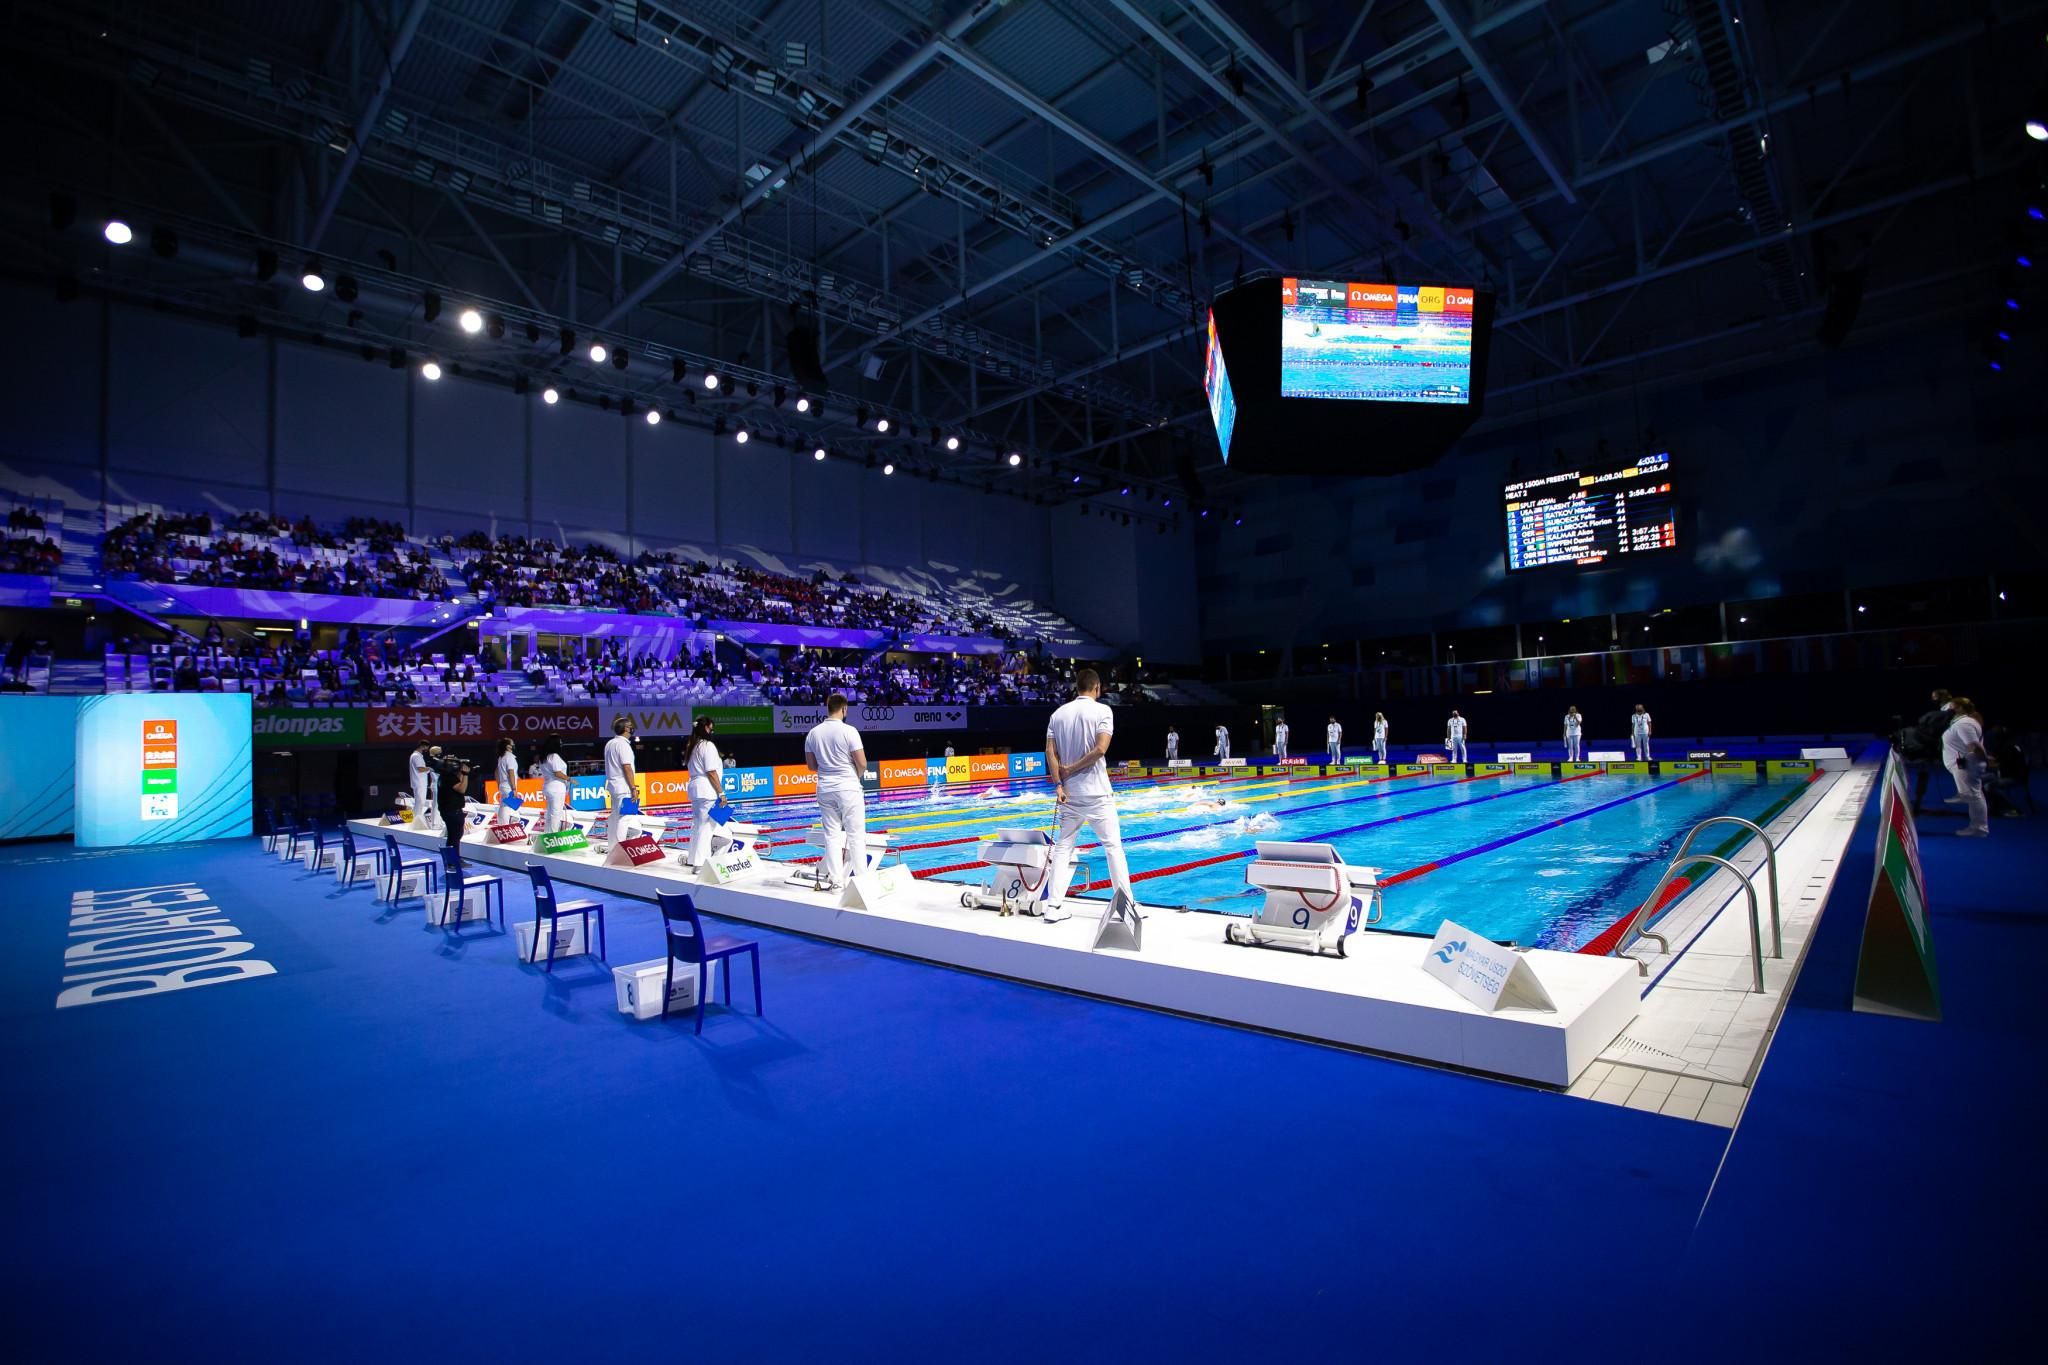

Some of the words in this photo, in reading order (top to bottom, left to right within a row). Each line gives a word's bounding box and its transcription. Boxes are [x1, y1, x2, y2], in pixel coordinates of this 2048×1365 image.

[1363, 292, 1393, 302] OMEGA
[1525, 479, 1545, 489] 1500M
[1546, 471, 1580, 483] FREESTYLE
[1505, 491, 1522, 500] HEAT
[1520, 501, 1536, 510] SPLIT
[525, 715, 593, 730] OMEGA
[914, 712, 941, 723] arena
[253, 715, 344, 736] alonpas
[376, 712, 482, 737] 农夫山泉
[894, 767, 924, 778] OMEGA
[981, 763, 1006, 771] OMEGA
[741, 778, 768, 786] RESULTS
[791, 774, 818, 784] OMEG
[741, 785, 755, 793] APP
[637, 844, 659, 856] OMEGA
[1007, 879, 1021, 899] 8
[1293, 907, 1310, 930] 9
[1350, 905, 1358, 928] 9
[56, 882, 278, 1009] BUDAPEST
